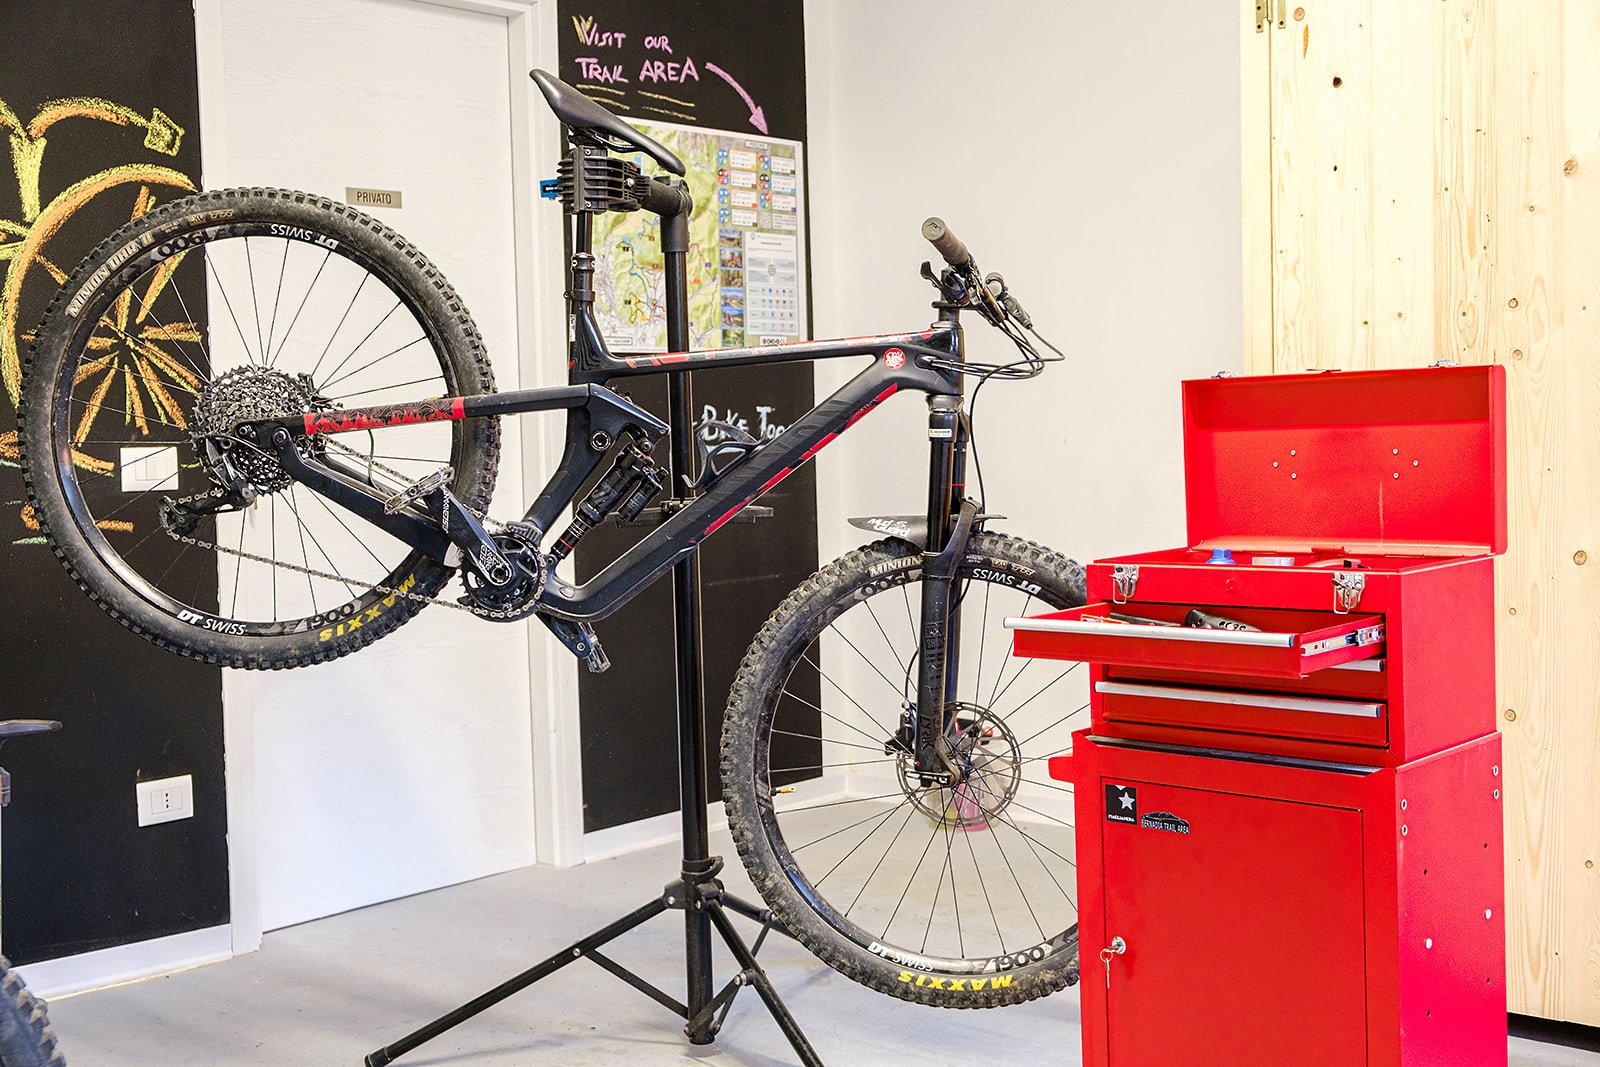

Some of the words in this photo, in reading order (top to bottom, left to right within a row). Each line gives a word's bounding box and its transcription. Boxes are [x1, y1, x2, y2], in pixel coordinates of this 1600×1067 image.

[572, 16, 626, 48] VISIT
[644, 35, 673, 54] OUR
[575, 57, 629, 84] TRAIL
[639, 56, 699, 83] AREA
[356, 191, 392, 205] PRIVATO
[270, 223, 313, 241] SWISS
[315, 235, 340, 250] DT
[66, 264, 111, 317] MINION
[756, 405, 793, 440] TOO
[868, 554, 923, 578] MINION
[972, 568, 1015, 585] SWISS
[1016, 580, 1042, 595] DT
[319, 573, 416, 642] MAXXIS
[176, 609, 204, 625] DT
[202, 618, 247, 636] SWISS
[867, 941, 892, 959] DT
[892, 953, 935, 973] SWISS
[897, 970, 1014, 991] MAXXIS
